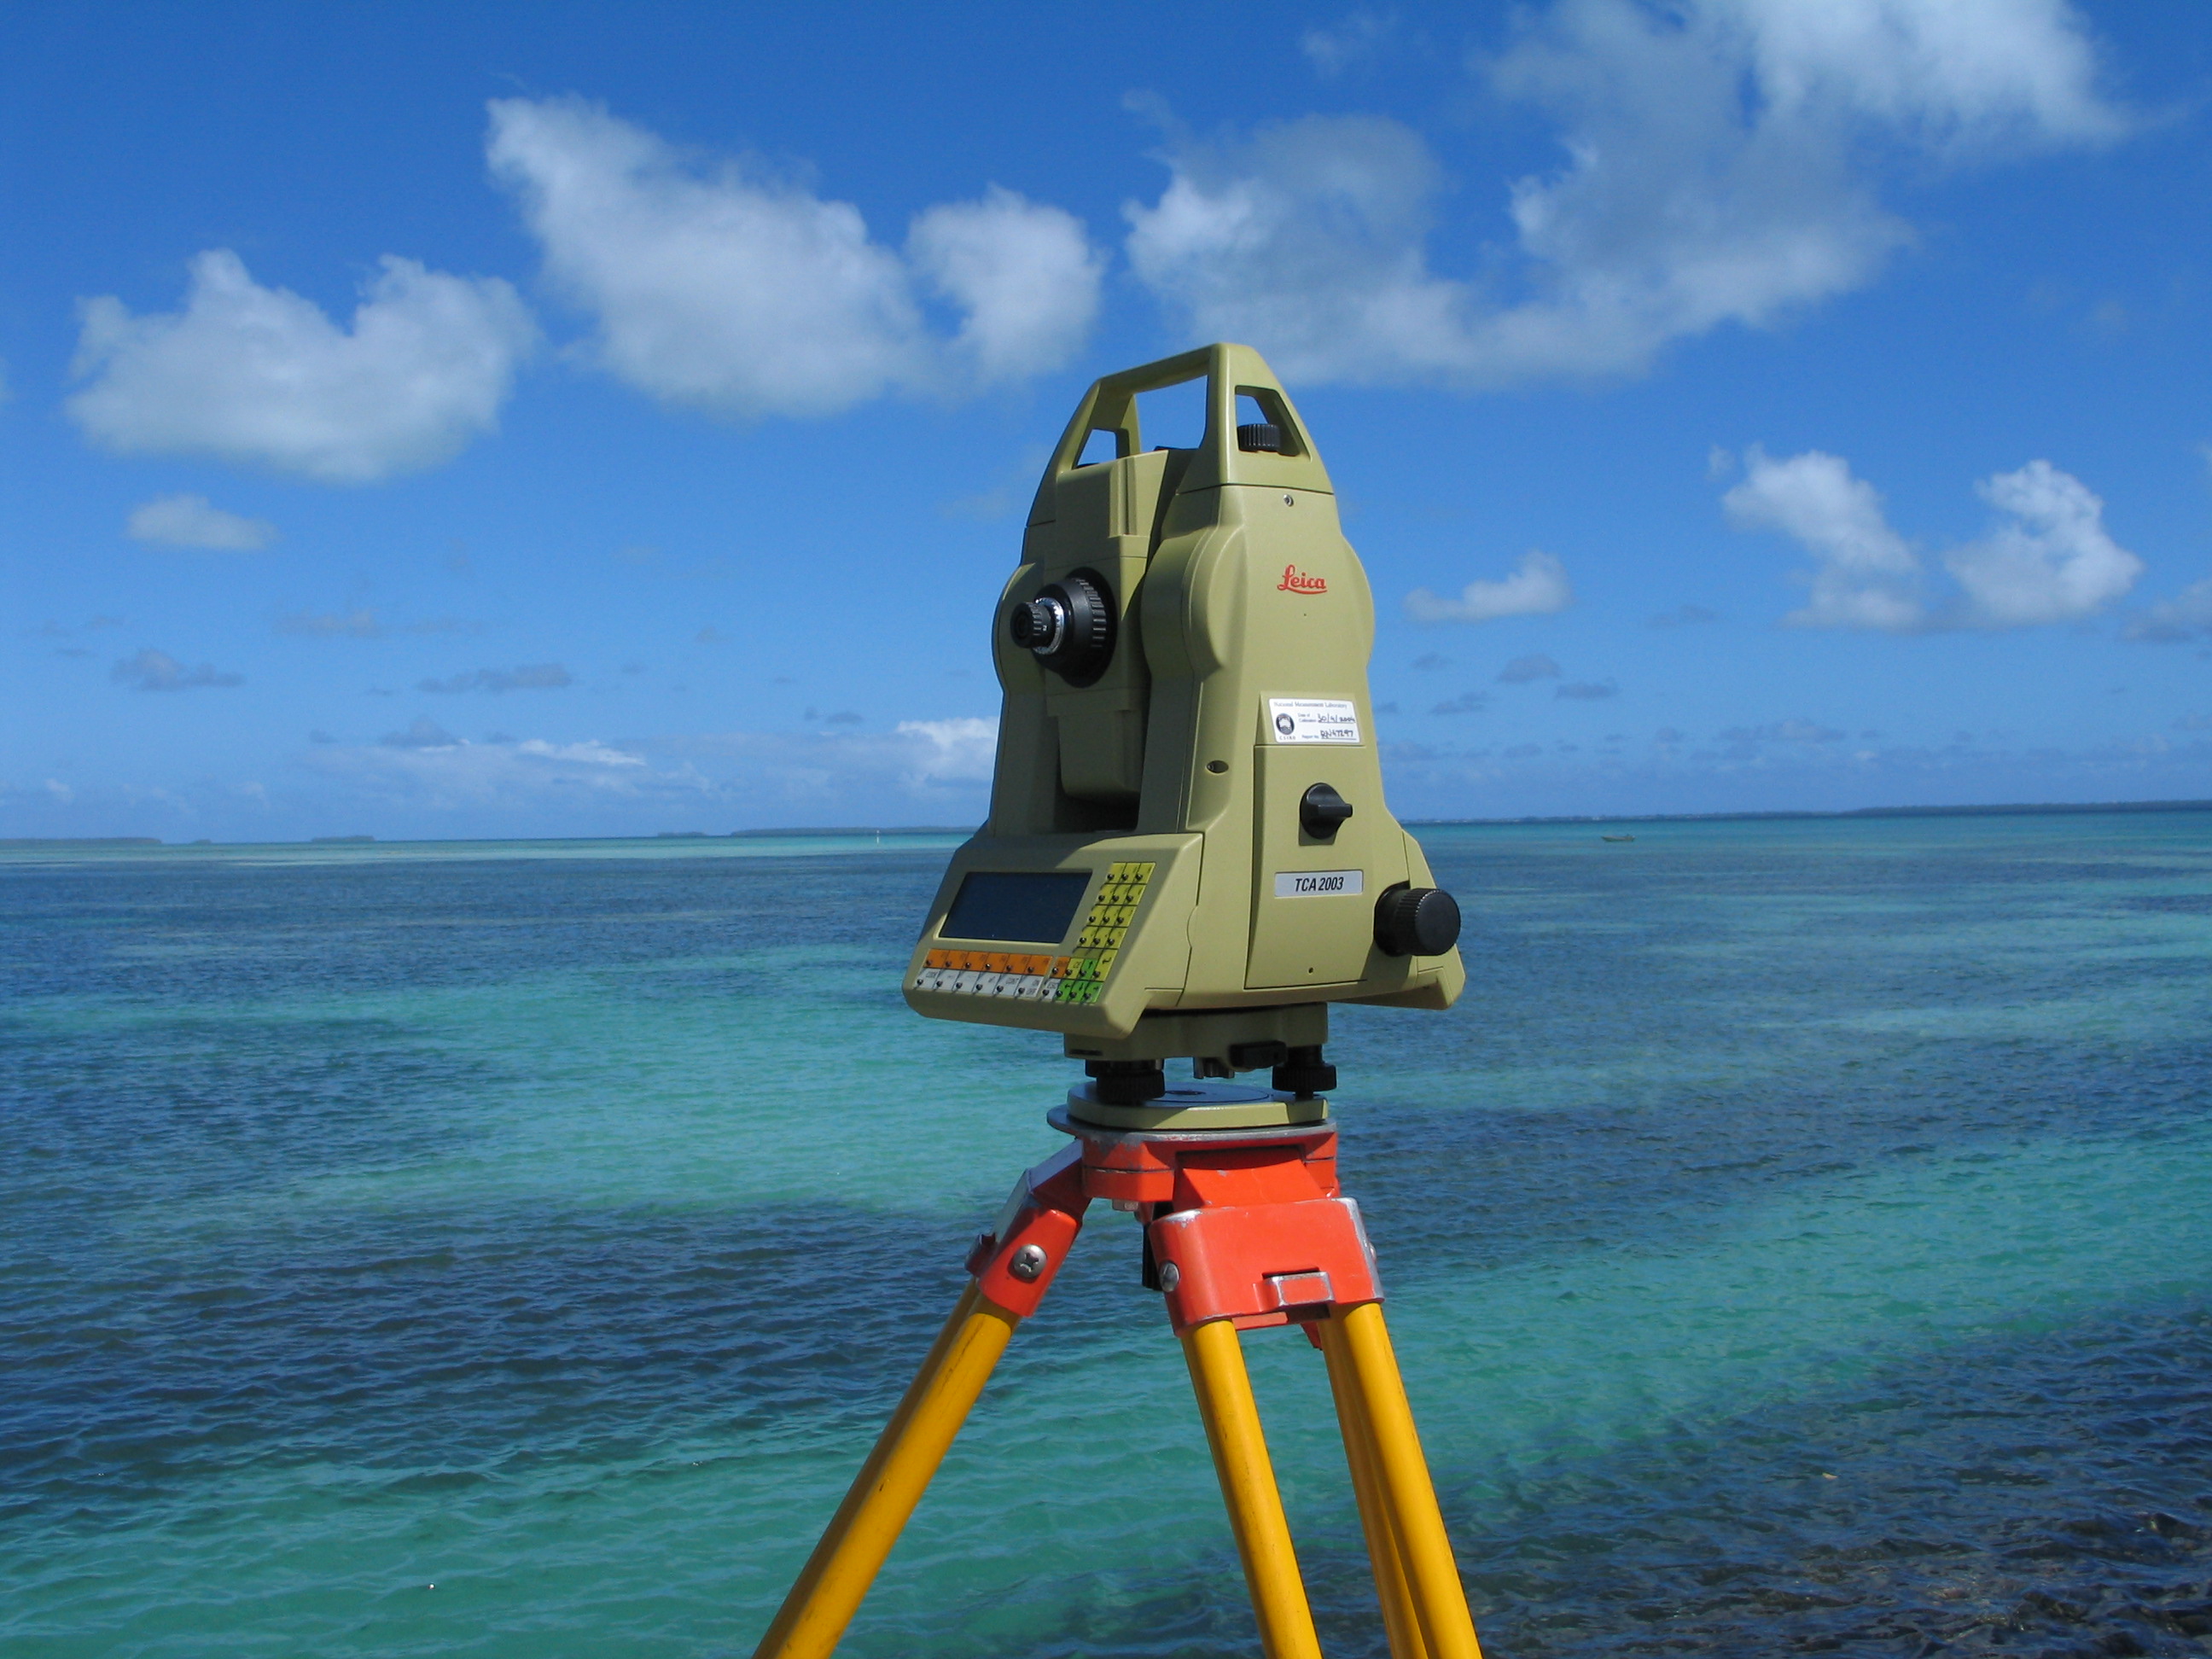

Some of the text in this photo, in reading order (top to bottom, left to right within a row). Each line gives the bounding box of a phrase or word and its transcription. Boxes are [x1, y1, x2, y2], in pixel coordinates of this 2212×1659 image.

[1277, 564, 1328, 595] Leica
[1295, 877, 1344, 892] TCA 2003
